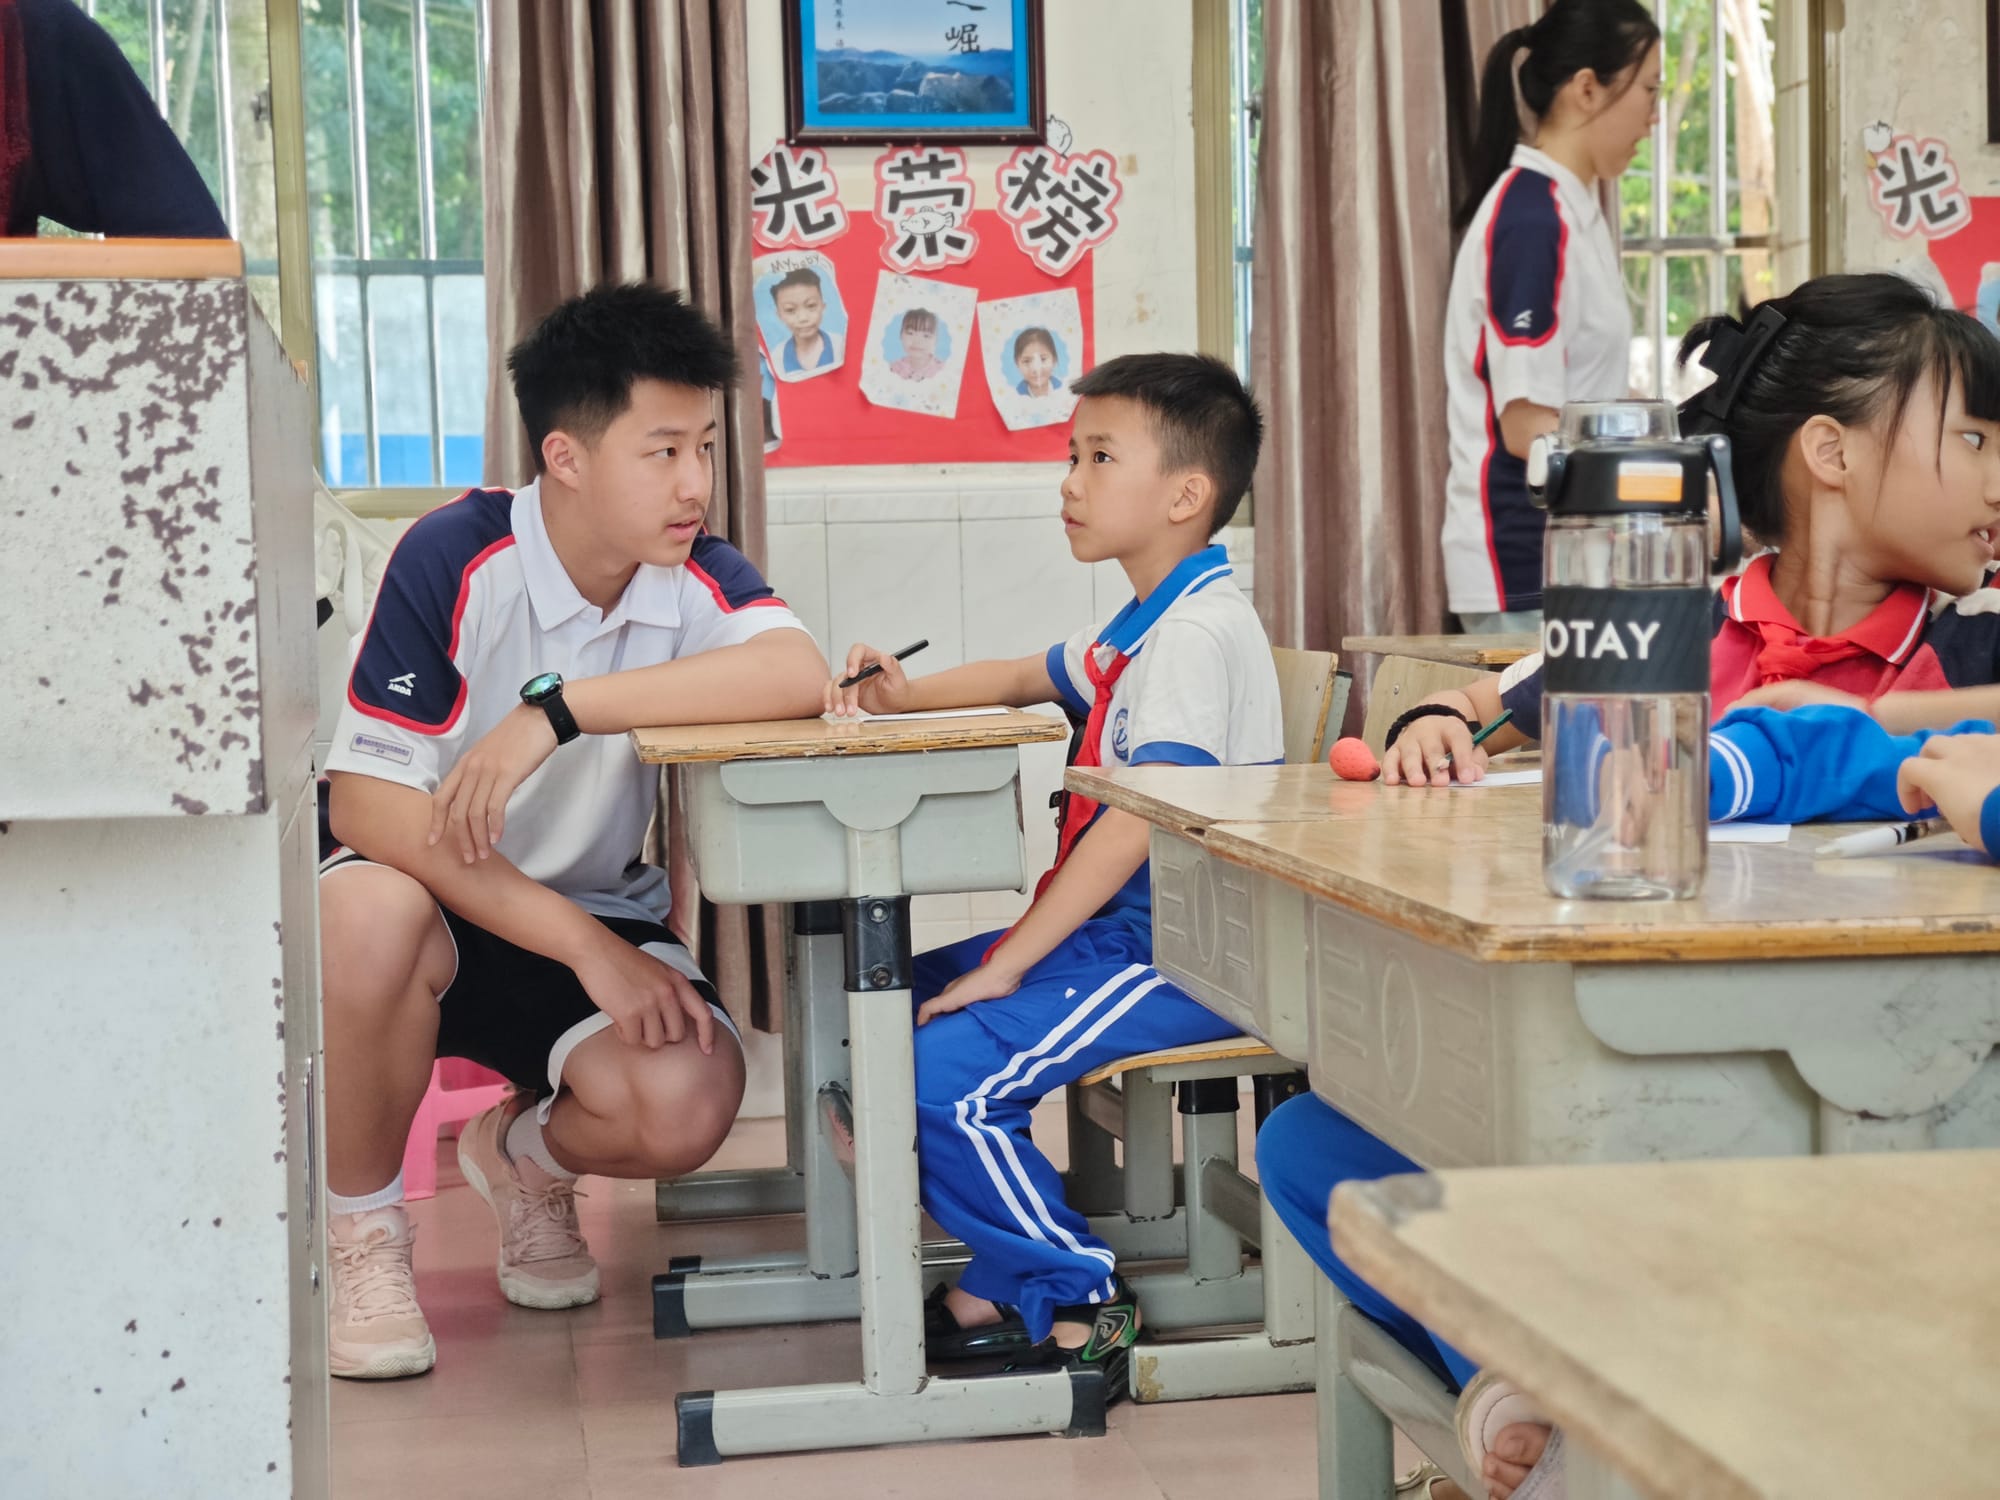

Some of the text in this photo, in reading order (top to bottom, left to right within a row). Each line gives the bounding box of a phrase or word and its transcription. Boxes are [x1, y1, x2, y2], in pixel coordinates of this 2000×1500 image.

[751, 151, 1110, 263] 光荣榜
[1878, 146, 1958, 227] 光
[1540, 619, 1661, 660] OTAY
